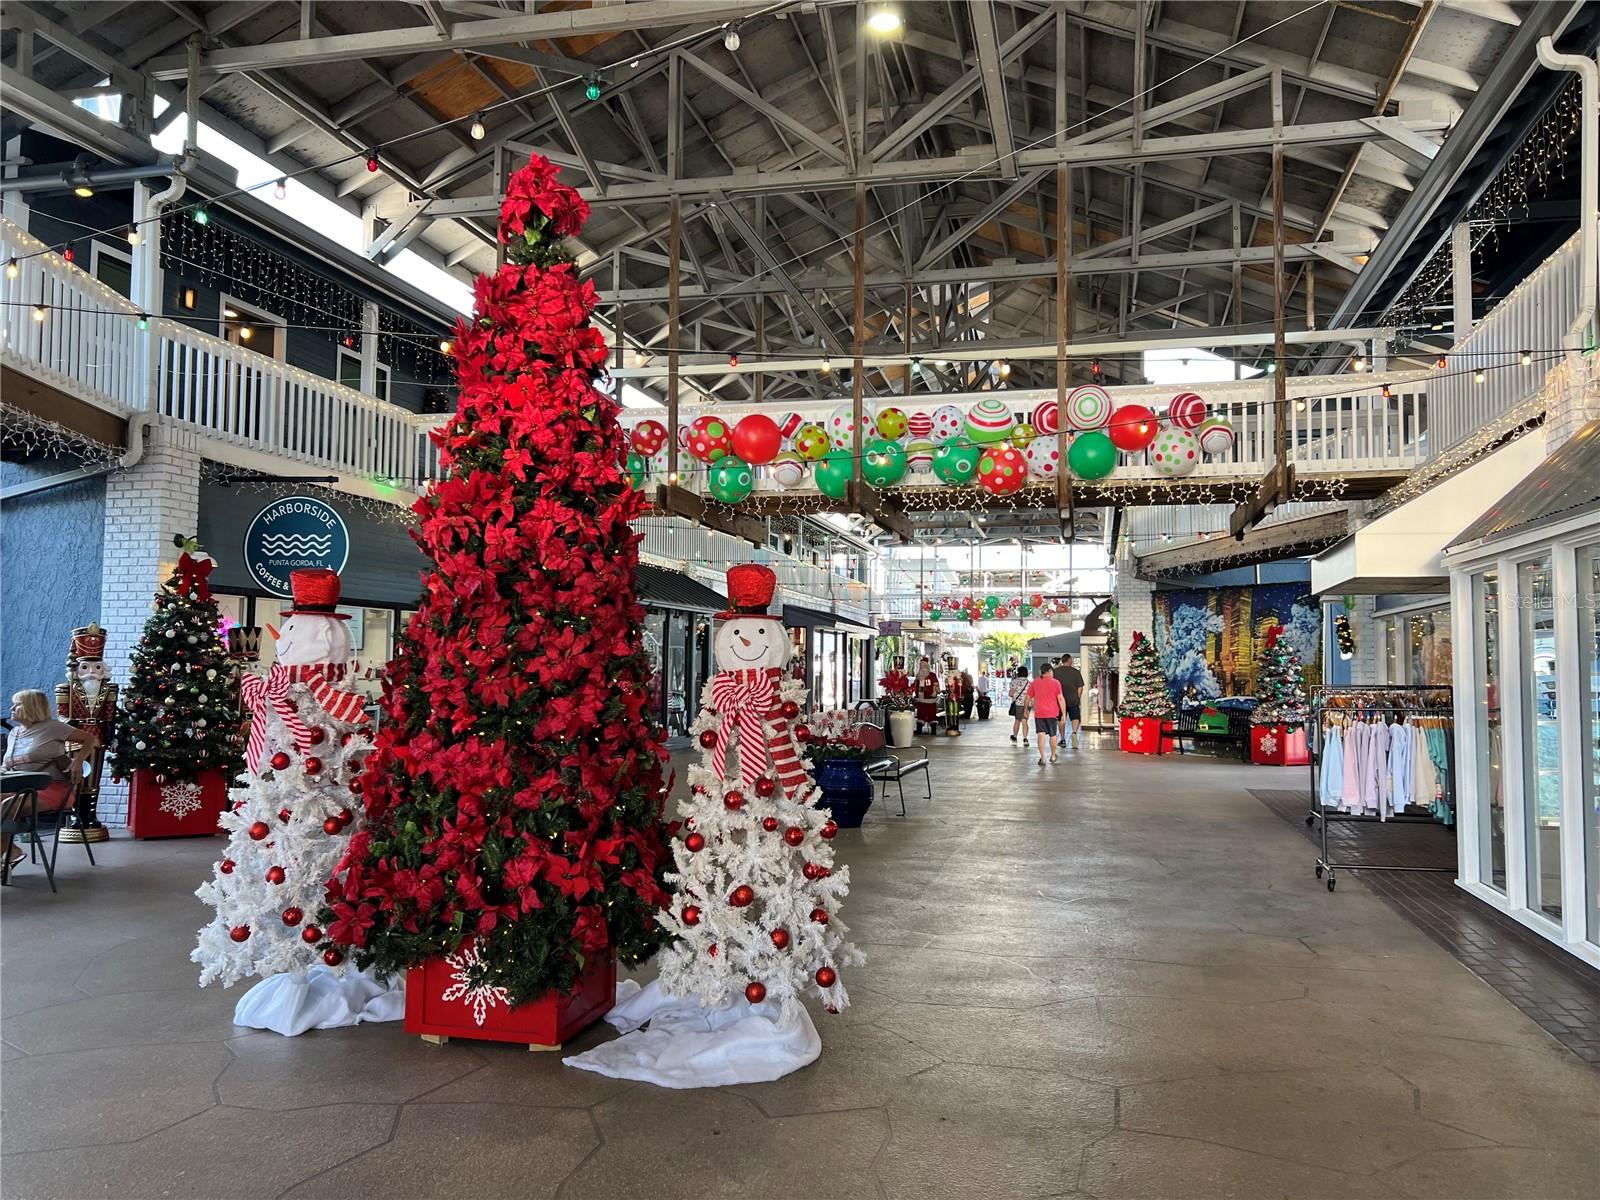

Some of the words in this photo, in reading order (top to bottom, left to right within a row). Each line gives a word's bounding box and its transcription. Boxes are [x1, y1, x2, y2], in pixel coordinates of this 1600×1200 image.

[262, 502, 337, 530] HARBORSIDE
[255, 562, 281, 588] COFFEE
[282, 582, 290, 591] &
[290, 559, 315, 567] GORDA,
